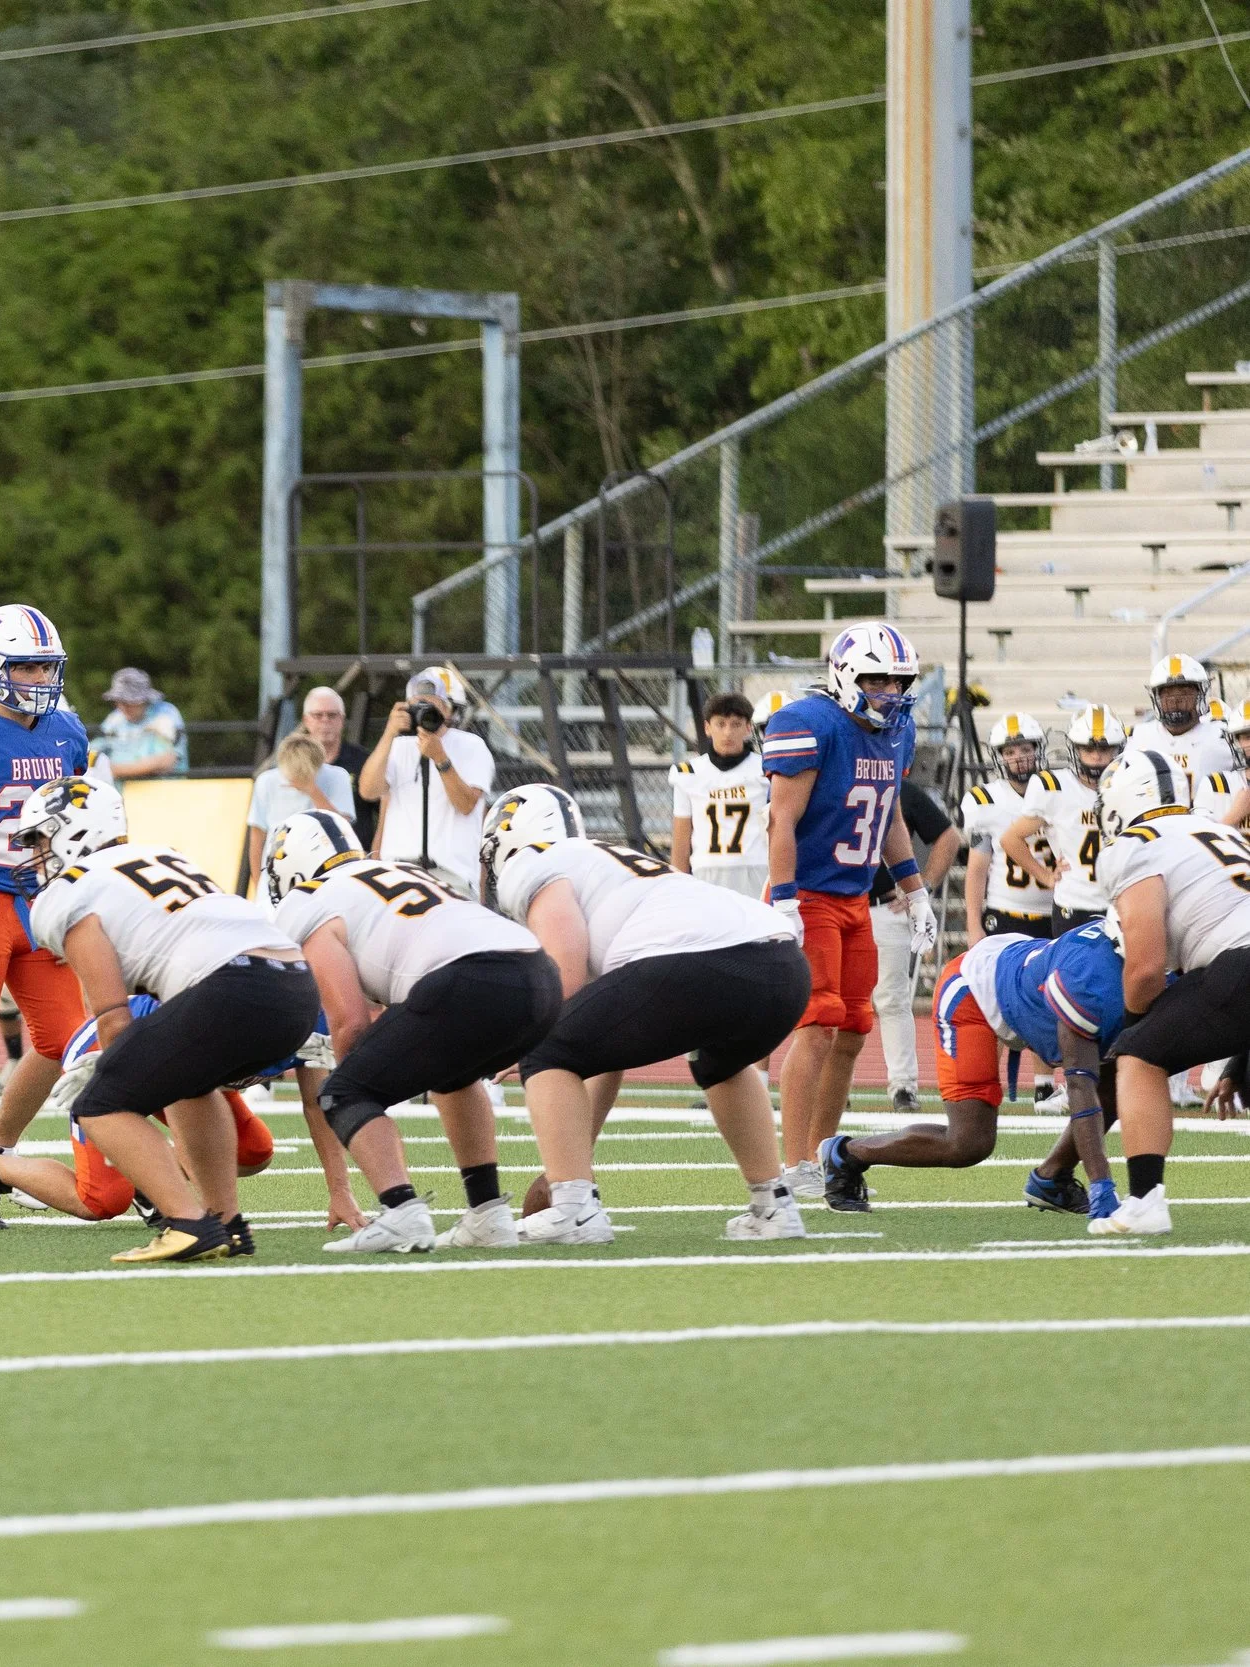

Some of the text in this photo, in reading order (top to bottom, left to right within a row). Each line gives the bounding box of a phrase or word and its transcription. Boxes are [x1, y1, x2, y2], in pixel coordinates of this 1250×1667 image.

[11, 758, 63, 781] BRUINS
[854, 758, 895, 781] BRUINS
[709, 785, 746, 799] NEERS
[706, 803, 751, 854] 17
[833, 784, 896, 866] 31
